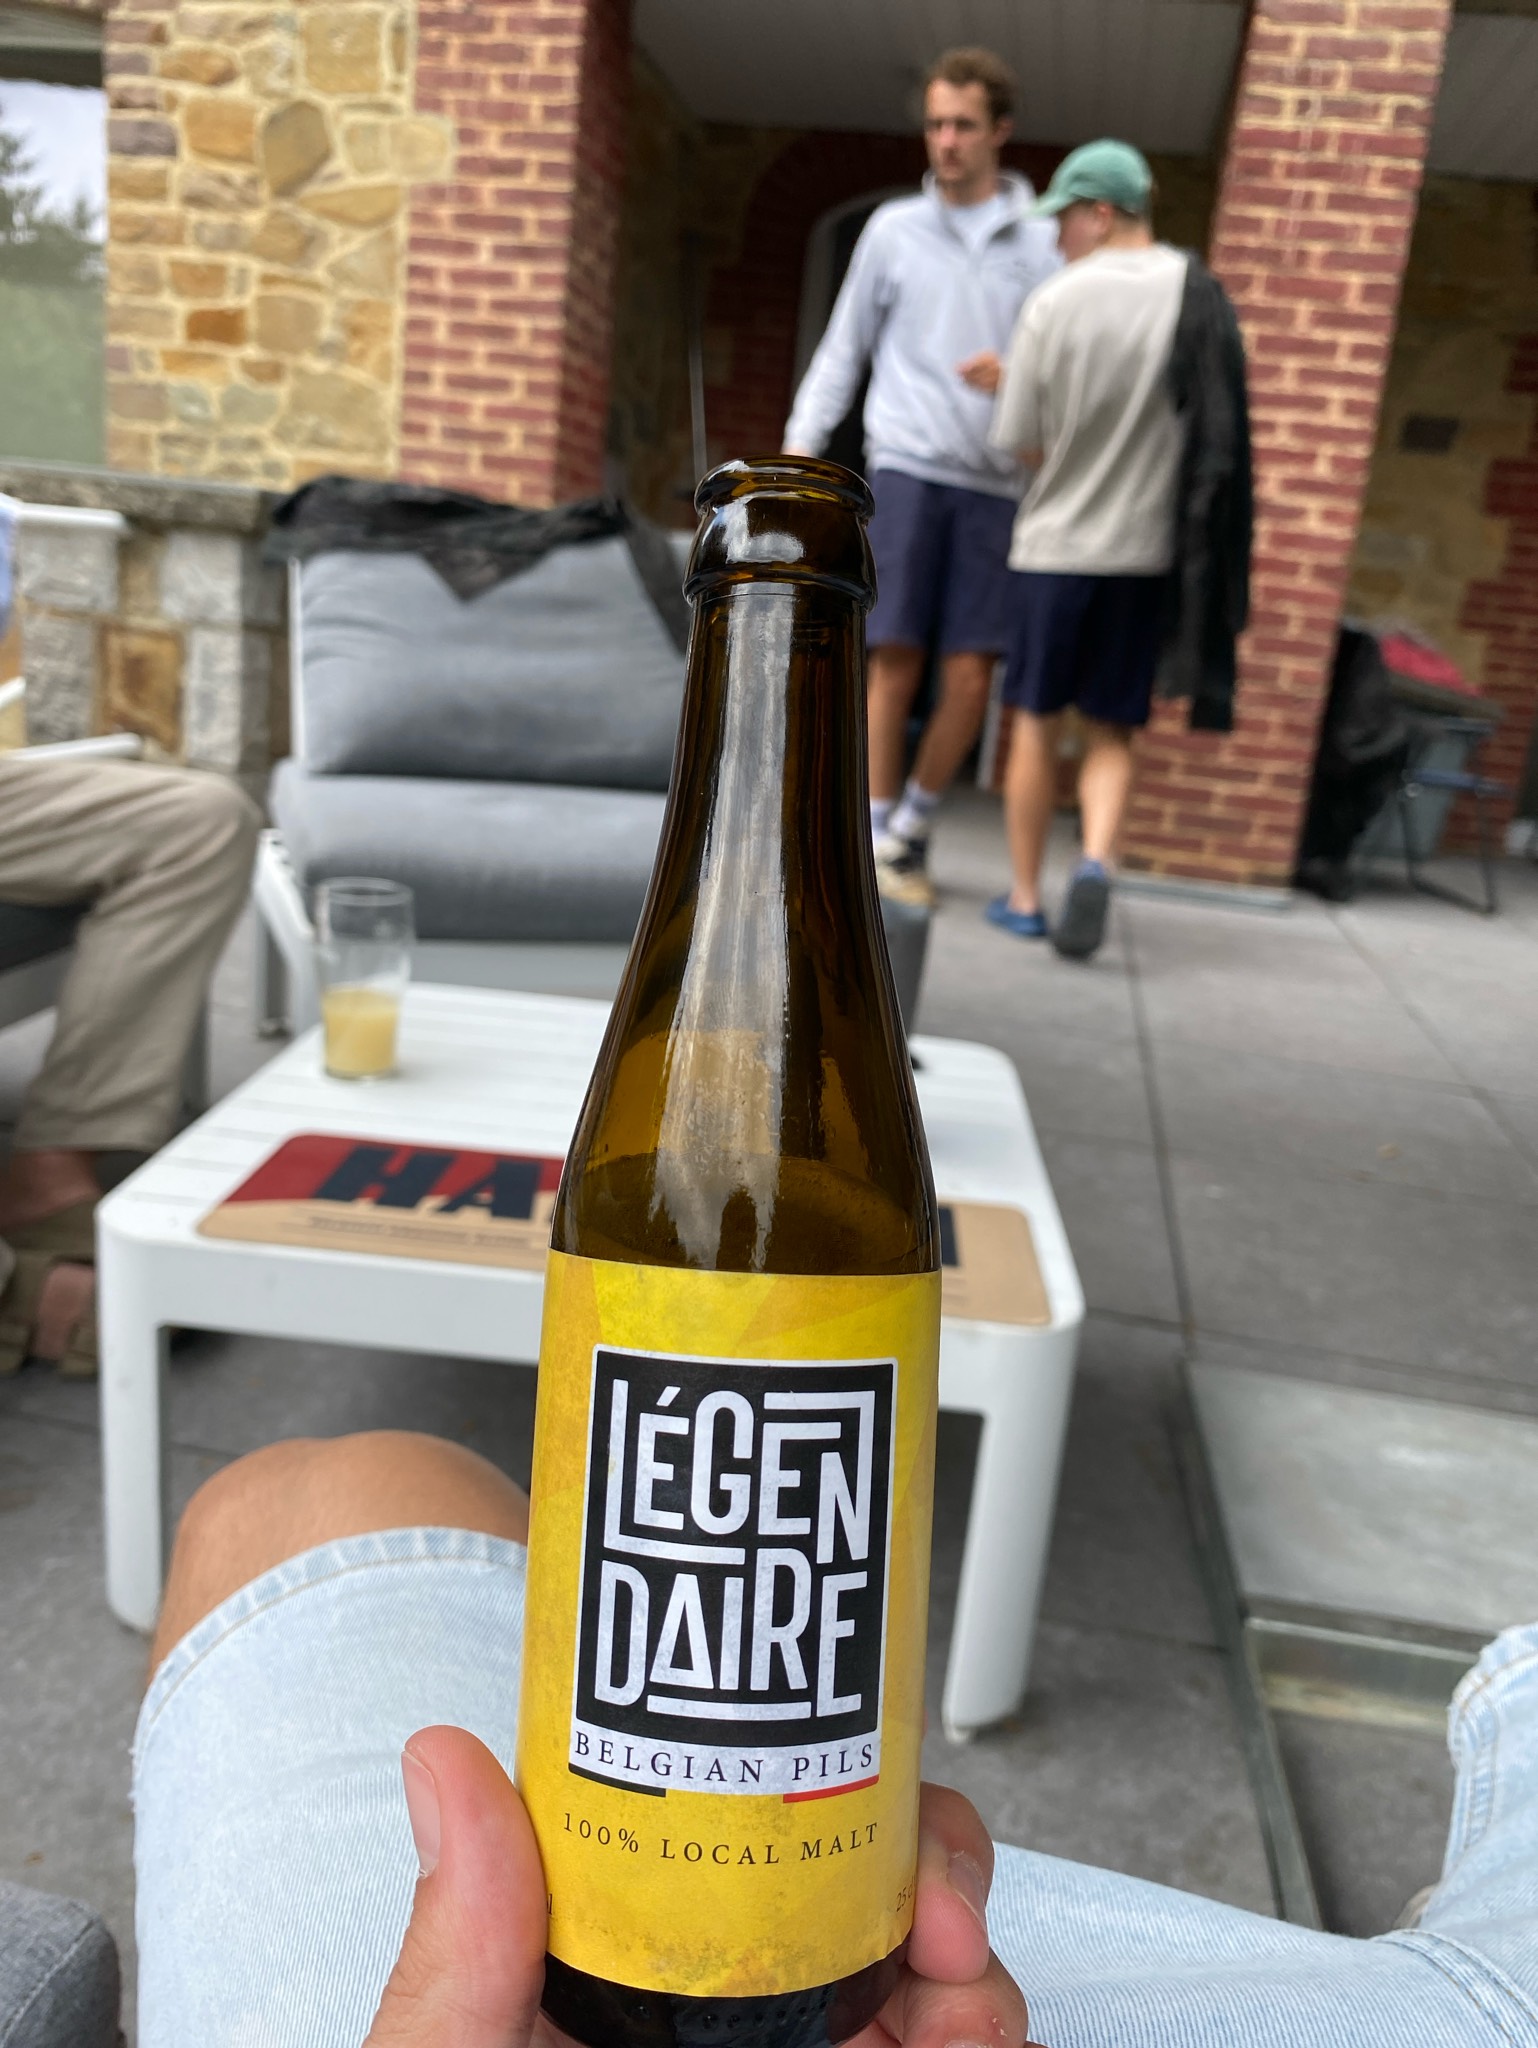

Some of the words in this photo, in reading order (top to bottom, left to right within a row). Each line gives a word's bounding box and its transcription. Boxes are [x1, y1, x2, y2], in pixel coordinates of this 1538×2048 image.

[604, 1378, 876, 1566] LÉGEN
[575, 1731, 764, 1783] BELGIAN
[792, 1743, 872, 1781] PILS
[564, 1812, 639, 1853] 100%
[660, 1838, 780, 1866] LOCAL
[800, 1822, 878, 1861] MALT
